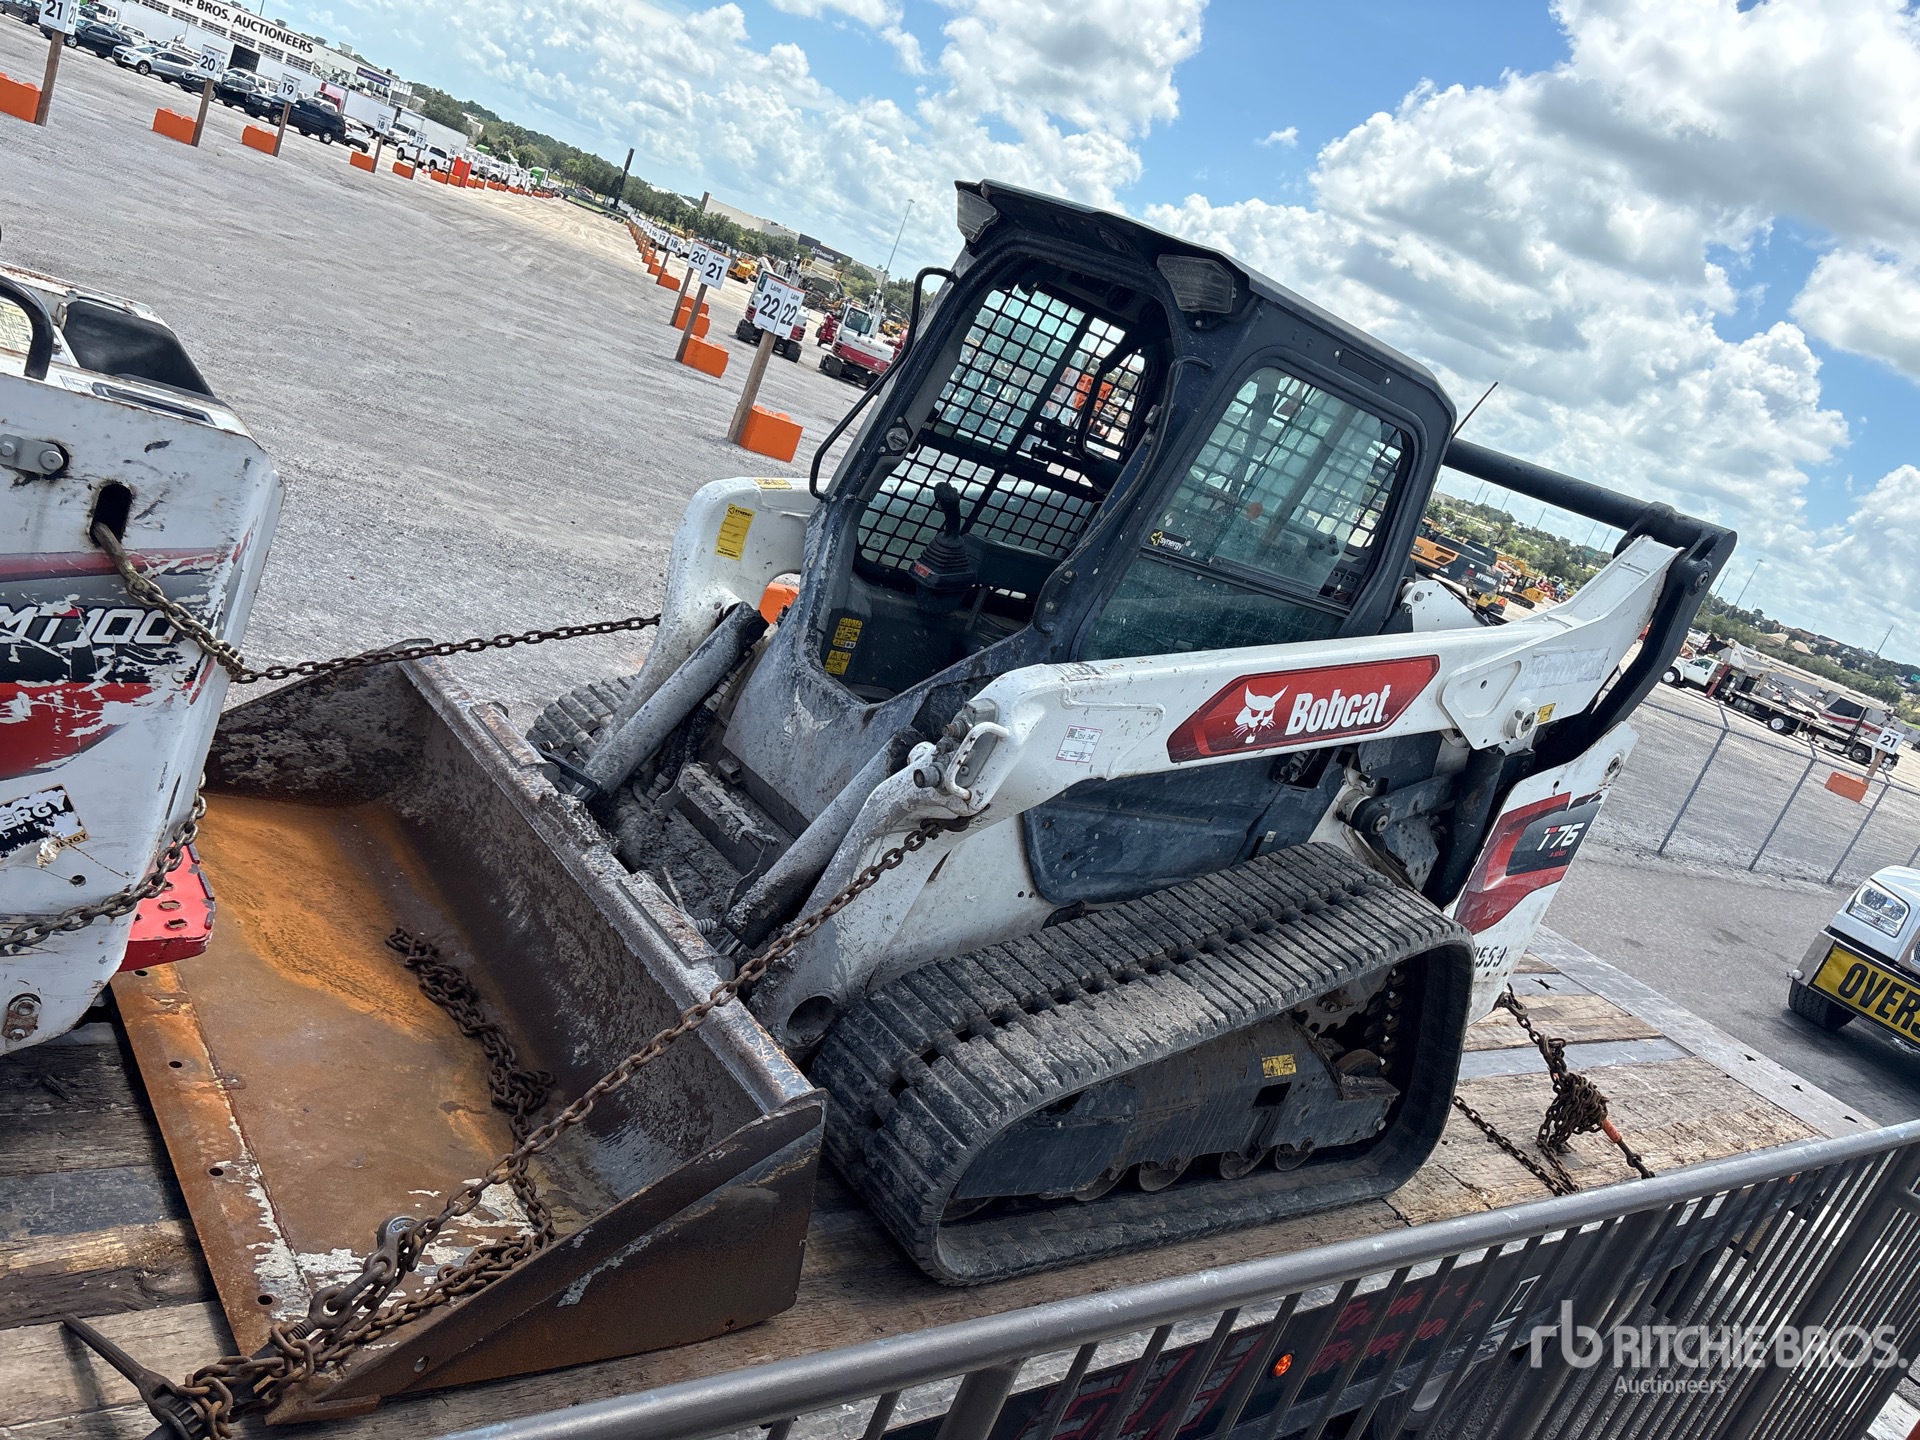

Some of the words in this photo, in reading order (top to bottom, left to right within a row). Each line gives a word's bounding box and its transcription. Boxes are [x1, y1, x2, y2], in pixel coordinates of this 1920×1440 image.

[44, 0, 63, 20] 21
[196, 0, 230, 21] BROS.
[233, 14, 314, 54] AUCTIONEERS
[200, 55, 216, 71] 20
[282, 82, 294, 95] 19
[659, 233, 666, 242] 17
[670, 239, 678, 248] 18
[691, 251, 706, 265] 20
[713, 254, 725, 263] Lane
[705, 262, 723, 281] 21
[770, 283, 782, 293] Lane
[759, 294, 780, 320] 22
[780, 303, 797, 326] 22
[1160, 537, 1183, 551] synergy
[1285, 684, 1392, 736] Bobcat
[1880, 735, 1897, 748] 21
